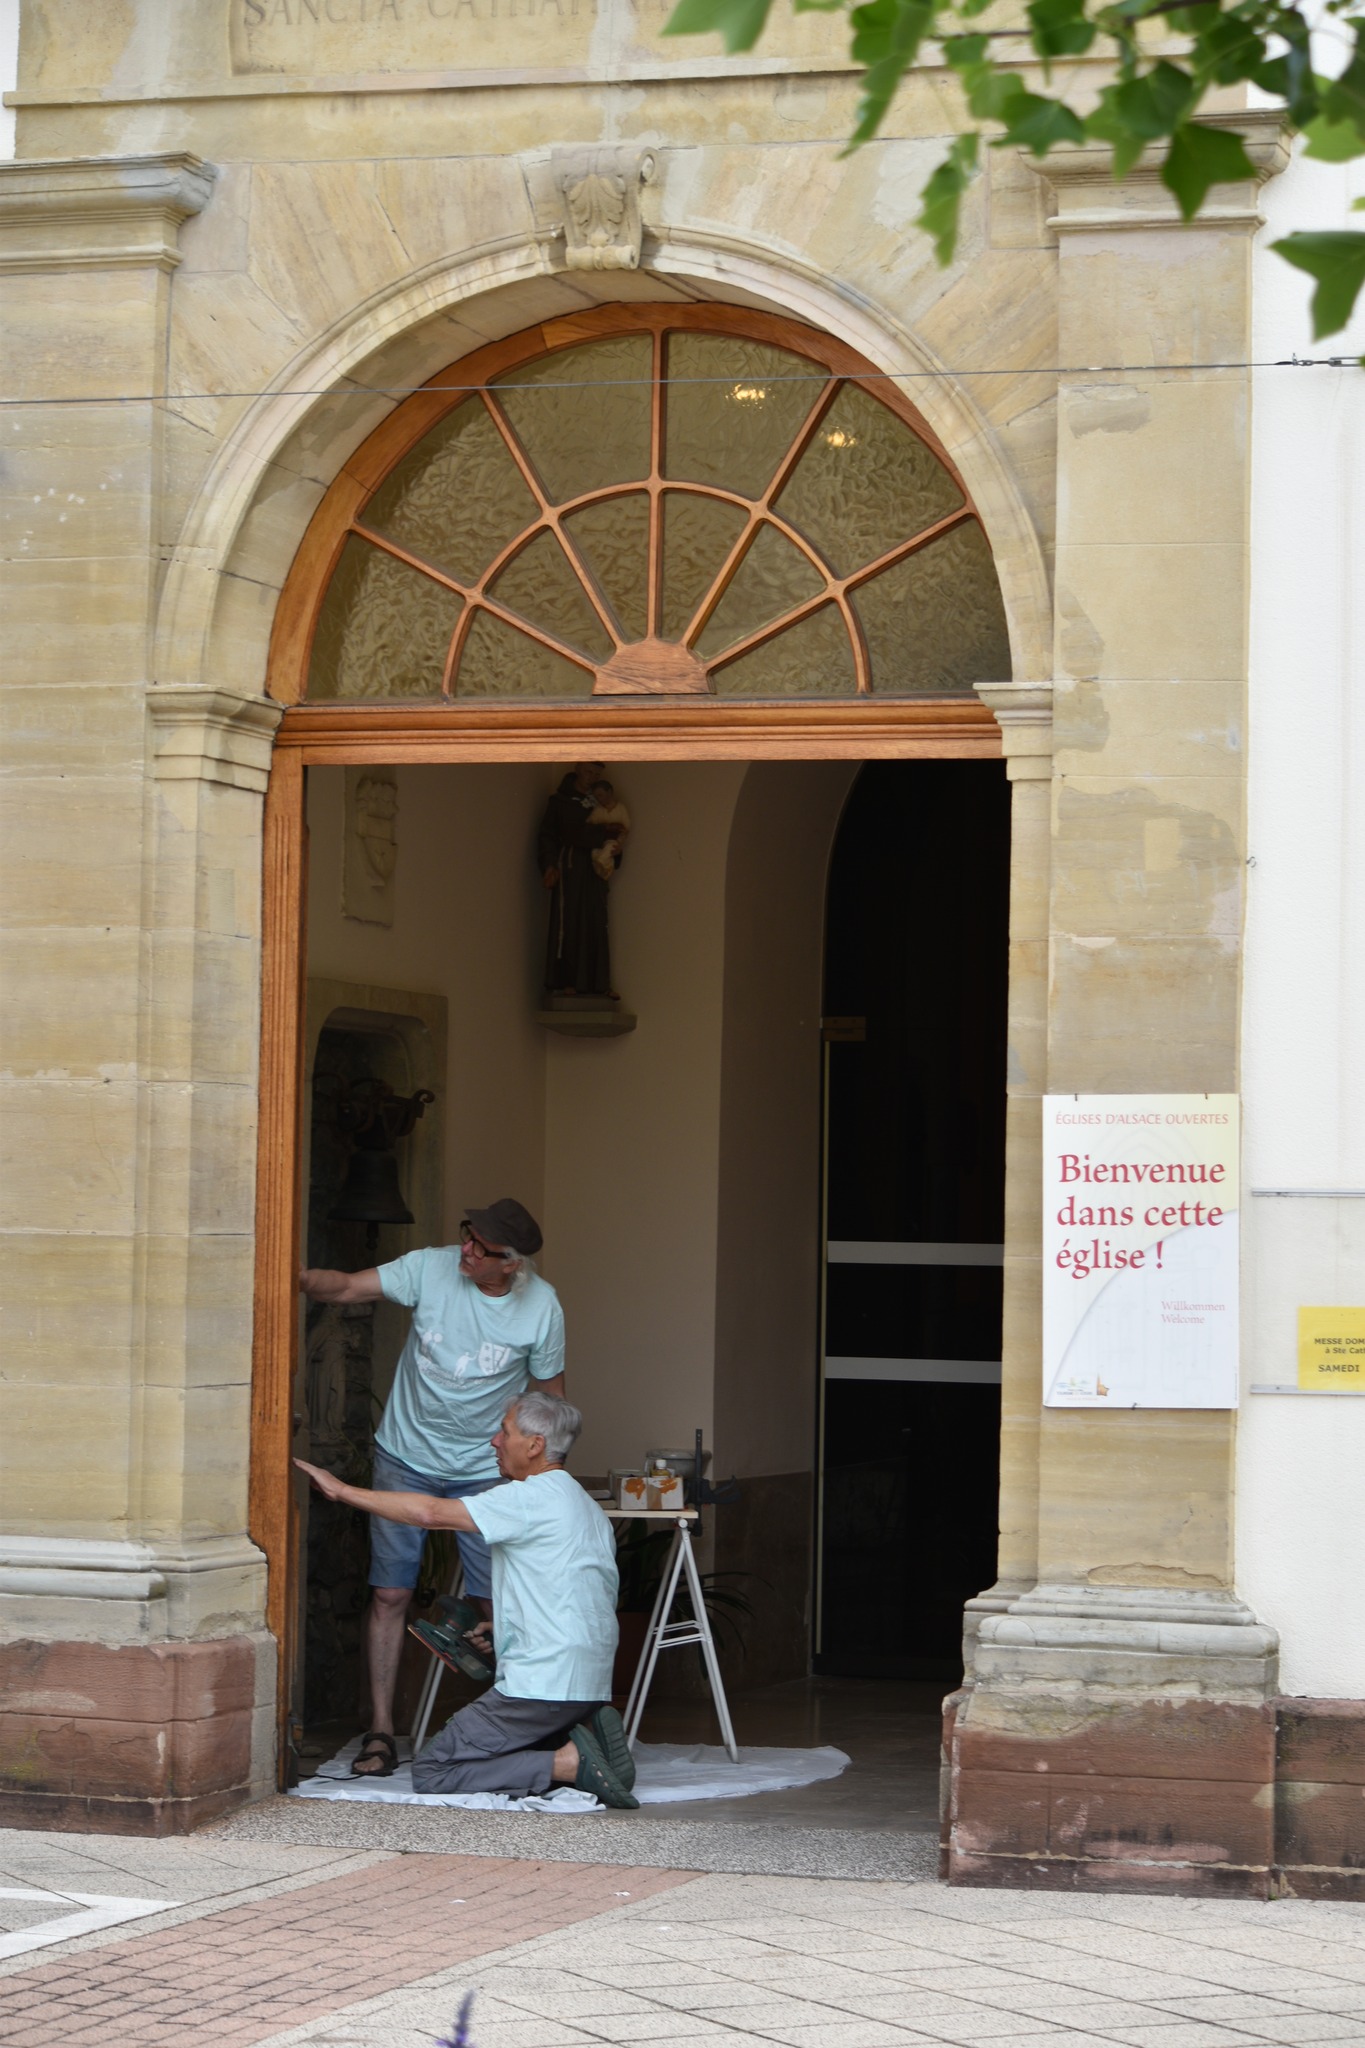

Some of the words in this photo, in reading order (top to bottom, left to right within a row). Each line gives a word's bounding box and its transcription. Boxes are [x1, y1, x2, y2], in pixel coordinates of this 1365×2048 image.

[1055, 1111, 1102, 1125] ÉGLISES
[1105, 1113, 1162, 1125] D'ALSACE
[1165, 1113, 1229, 1125] OUVERTES
[1057, 1154, 1226, 1184] Bienvenue
[1056, 1196, 1134, 1227] dans
[1143, 1200, 1224, 1227] cette
[1055, 1238, 1146, 1280] église
[1155, 1240, 1164, 1270] !
[1161, 1300, 1226, 1312] Willkommen
[1161, 1313, 1206, 1324] Welcome
[1318, 1364, 1360, 1372] SAMEDI
